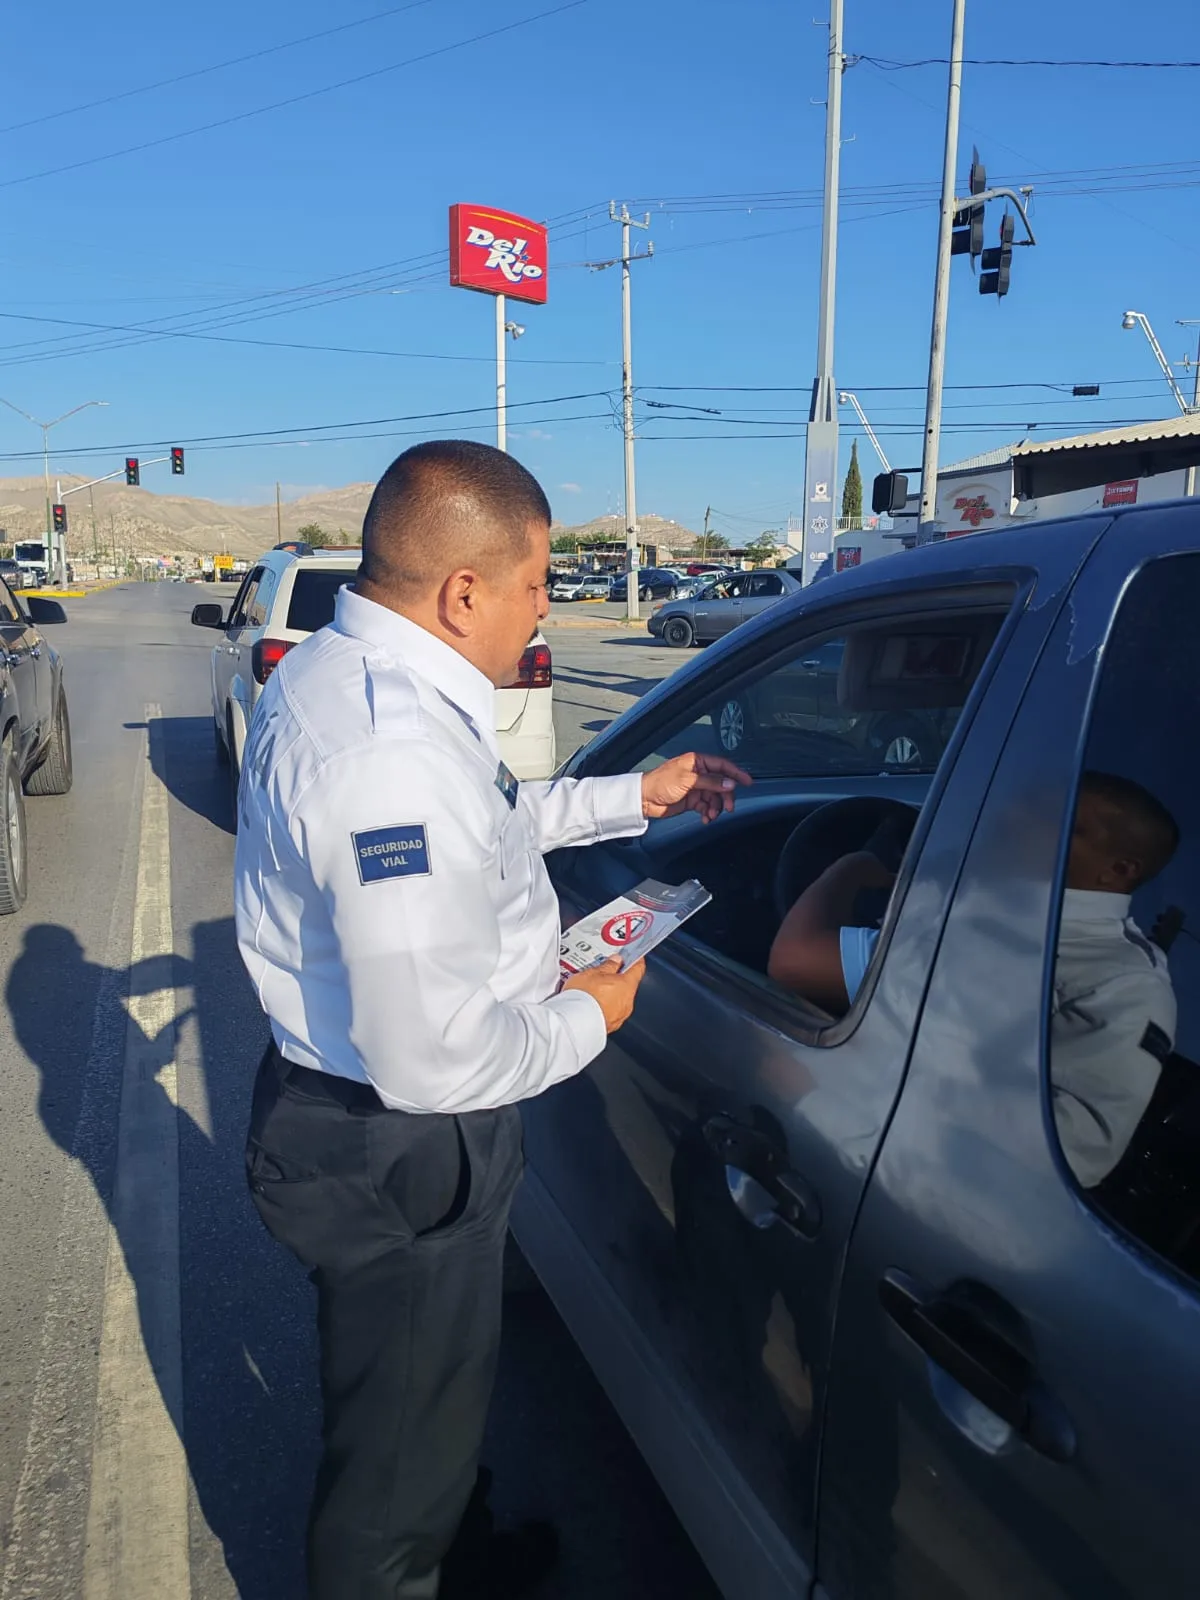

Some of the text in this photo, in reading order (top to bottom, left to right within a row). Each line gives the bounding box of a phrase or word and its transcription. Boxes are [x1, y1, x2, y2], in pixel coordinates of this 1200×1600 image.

[466, 226, 527, 255] Del
[360, 839, 424, 858] SEGURIDAD
[381, 855, 409, 868] VIAL
